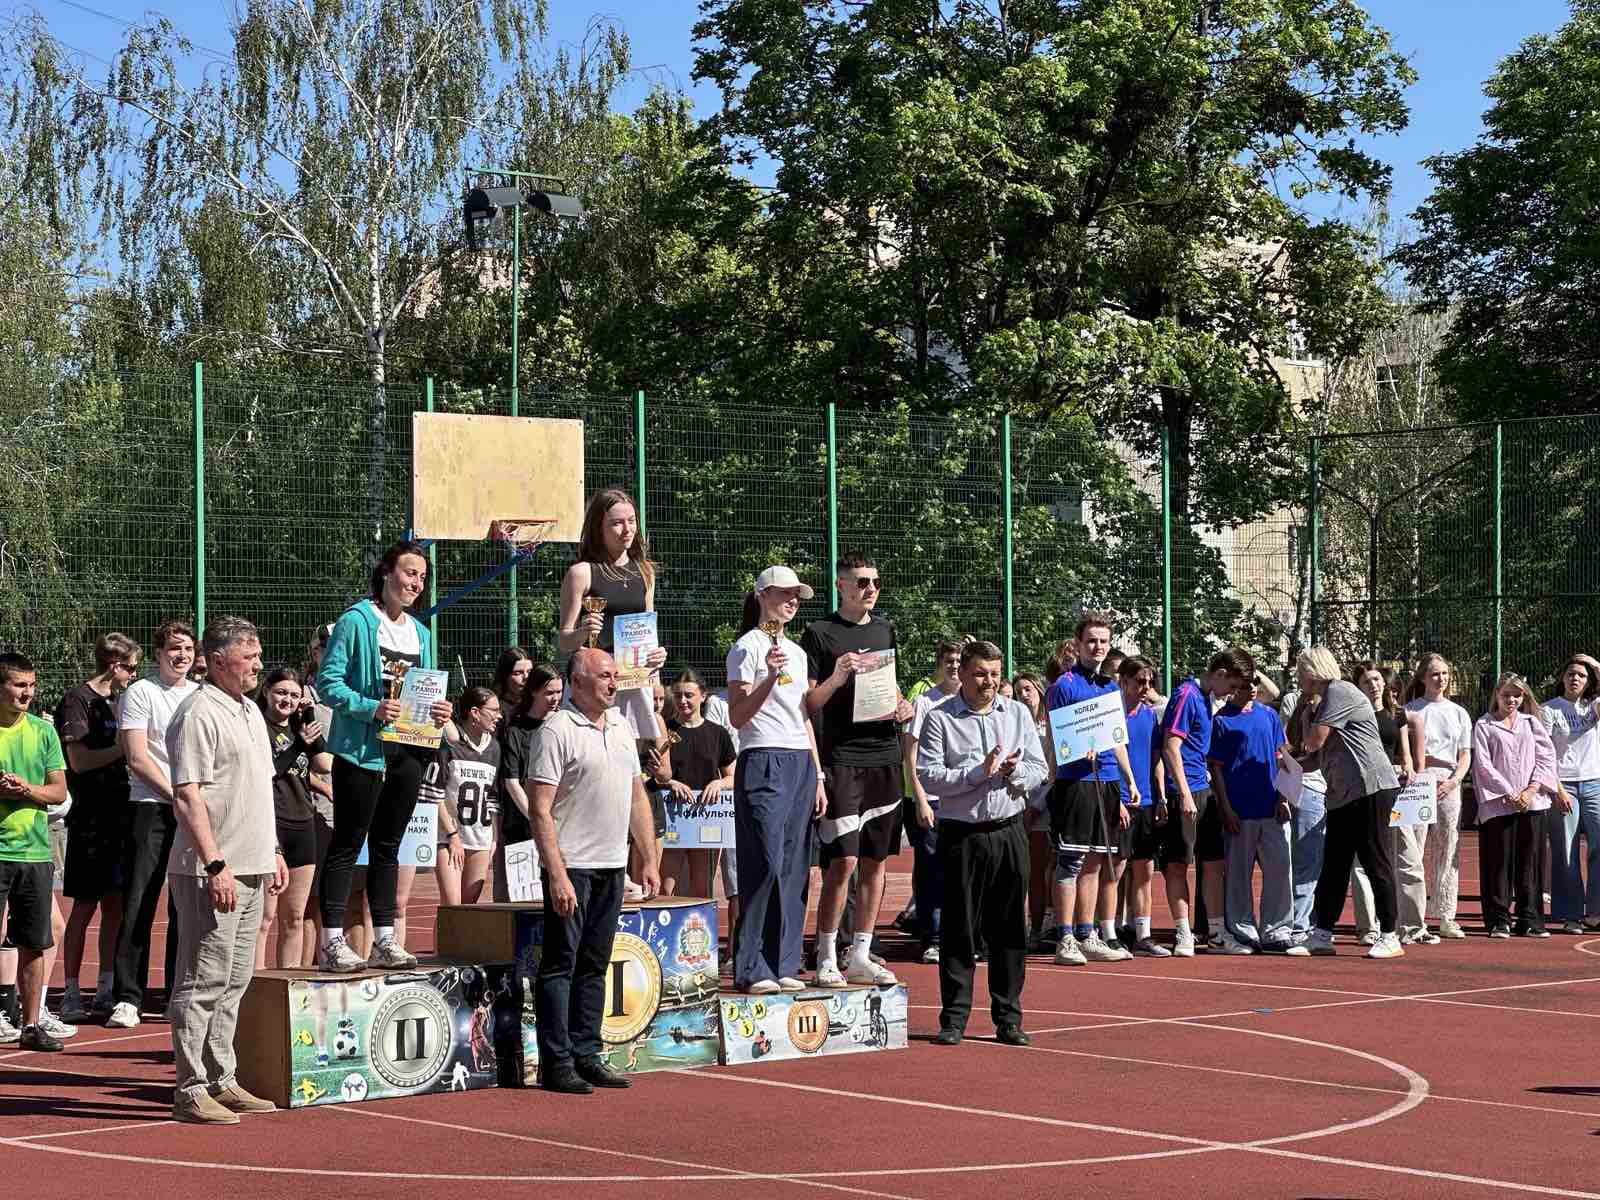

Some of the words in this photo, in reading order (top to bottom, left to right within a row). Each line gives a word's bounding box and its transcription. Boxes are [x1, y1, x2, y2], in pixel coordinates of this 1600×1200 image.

[683, 809, 735, 819] факульте
[798, 1015, 818, 1034] III
[392, 1017, 430, 1061] II
